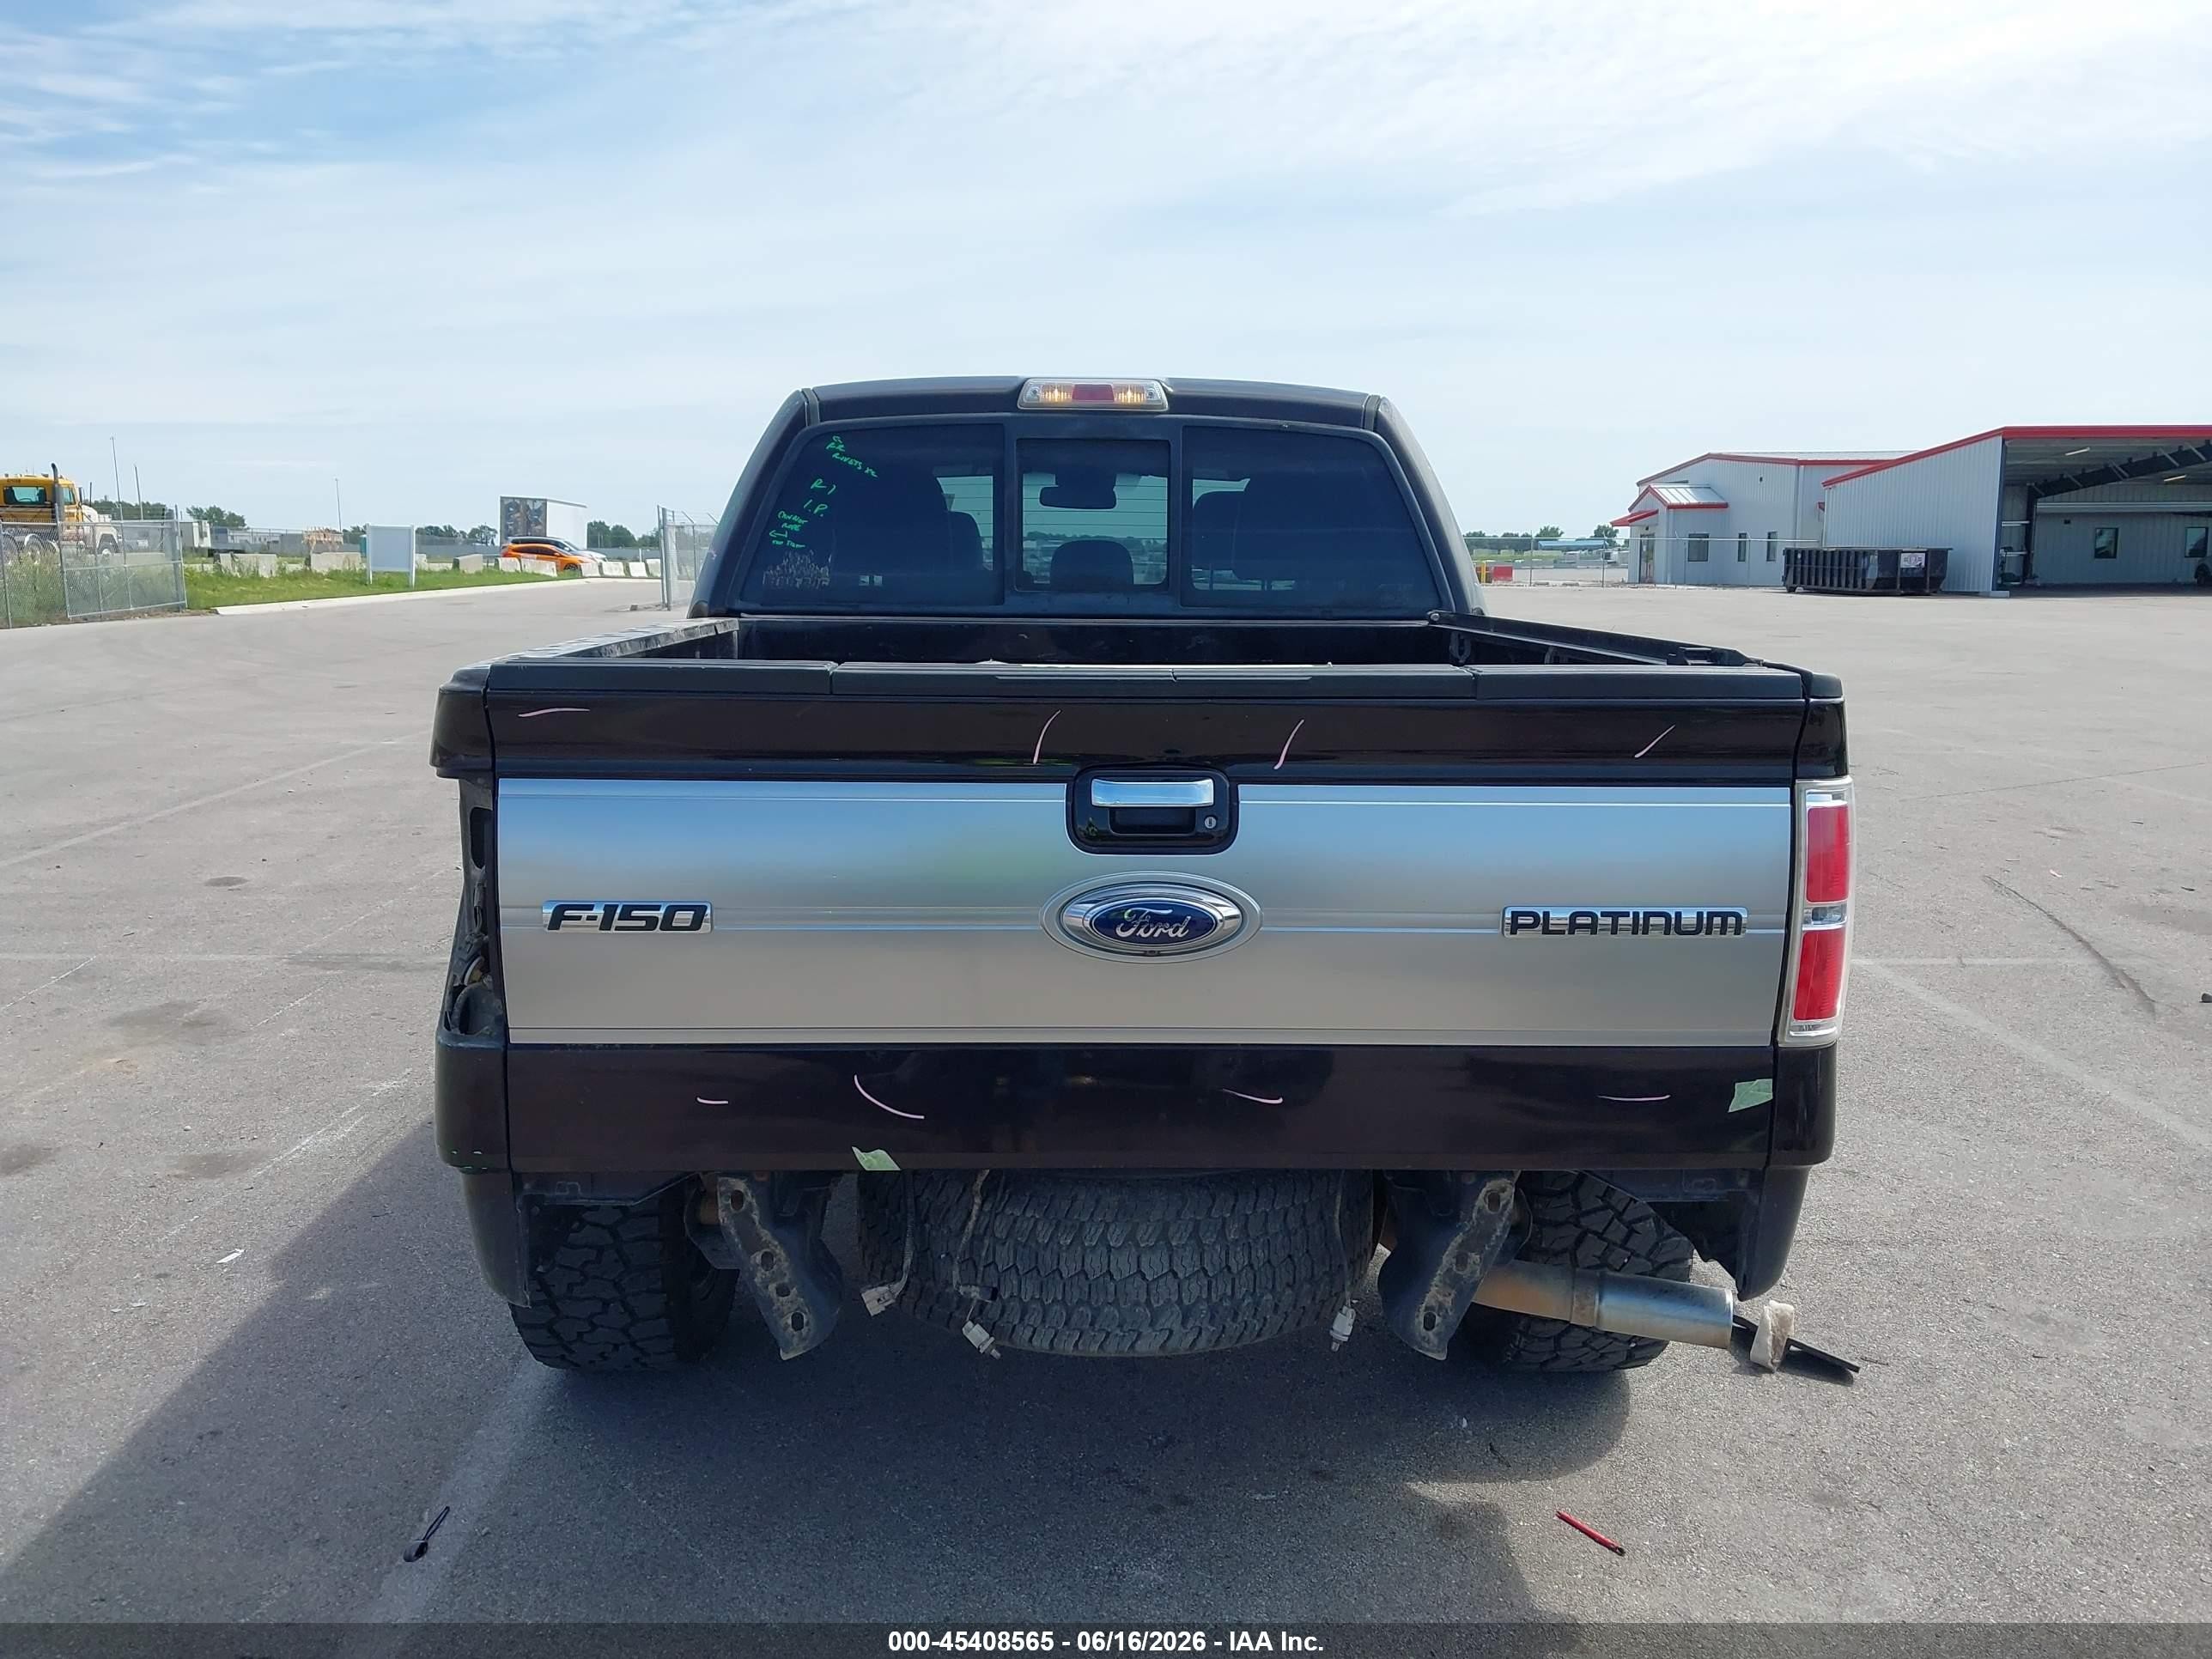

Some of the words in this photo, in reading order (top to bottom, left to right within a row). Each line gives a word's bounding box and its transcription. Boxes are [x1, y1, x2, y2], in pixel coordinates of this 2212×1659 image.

[547, 903, 708, 932] F-150
[1115, 907, 1192, 938] Ford
[1510, 910, 1744, 936] PLATINUM
